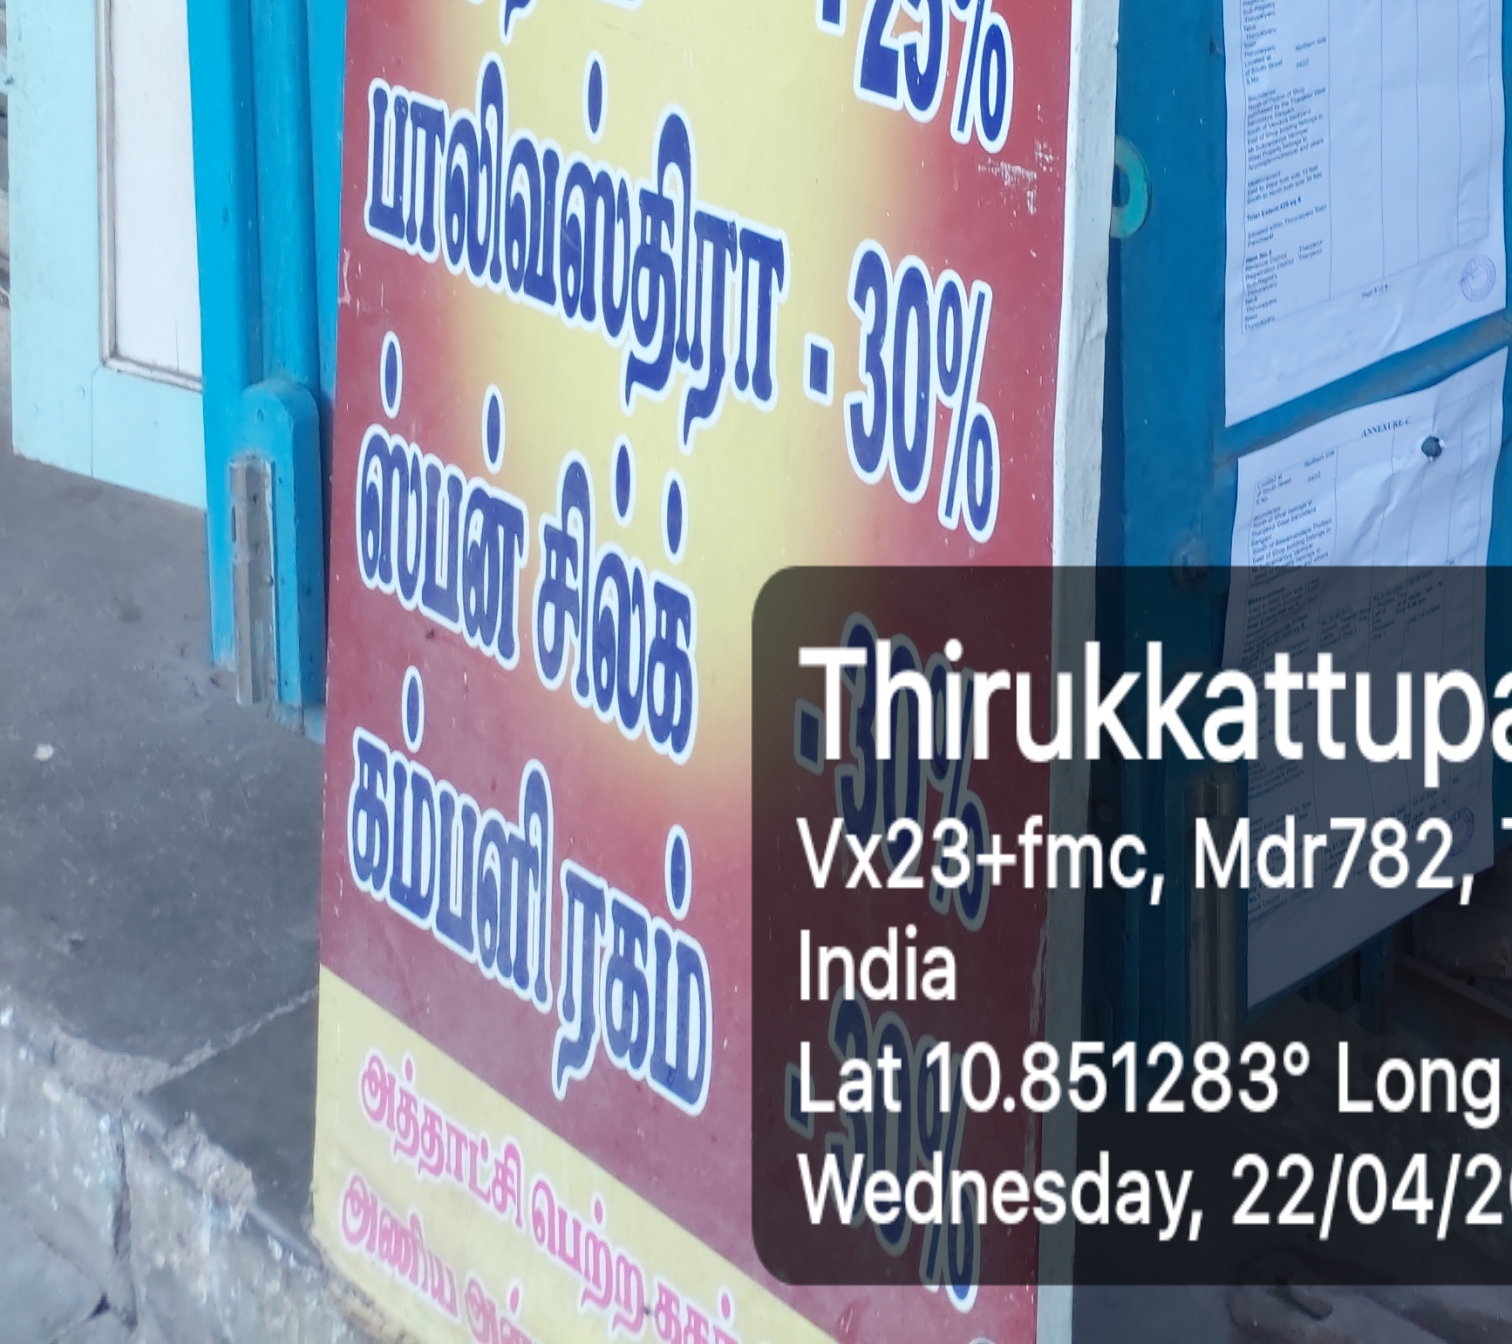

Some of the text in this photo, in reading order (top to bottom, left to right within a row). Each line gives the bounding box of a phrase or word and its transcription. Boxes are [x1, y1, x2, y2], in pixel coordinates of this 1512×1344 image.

[368, 57, 787, 445] பாலிவஸ்திரா
[359, 338, 525, 664] ஸ்பன்
[538, 438, 696, 759] சில்க்
[350, 670, 553, 1009] கம்பளி
[556, 829, 712, 1111] ரகம்
[360, 1053, 523, 1227] அத்தாட்சி
[531, 1181, 647, 1336] பெற்ற
